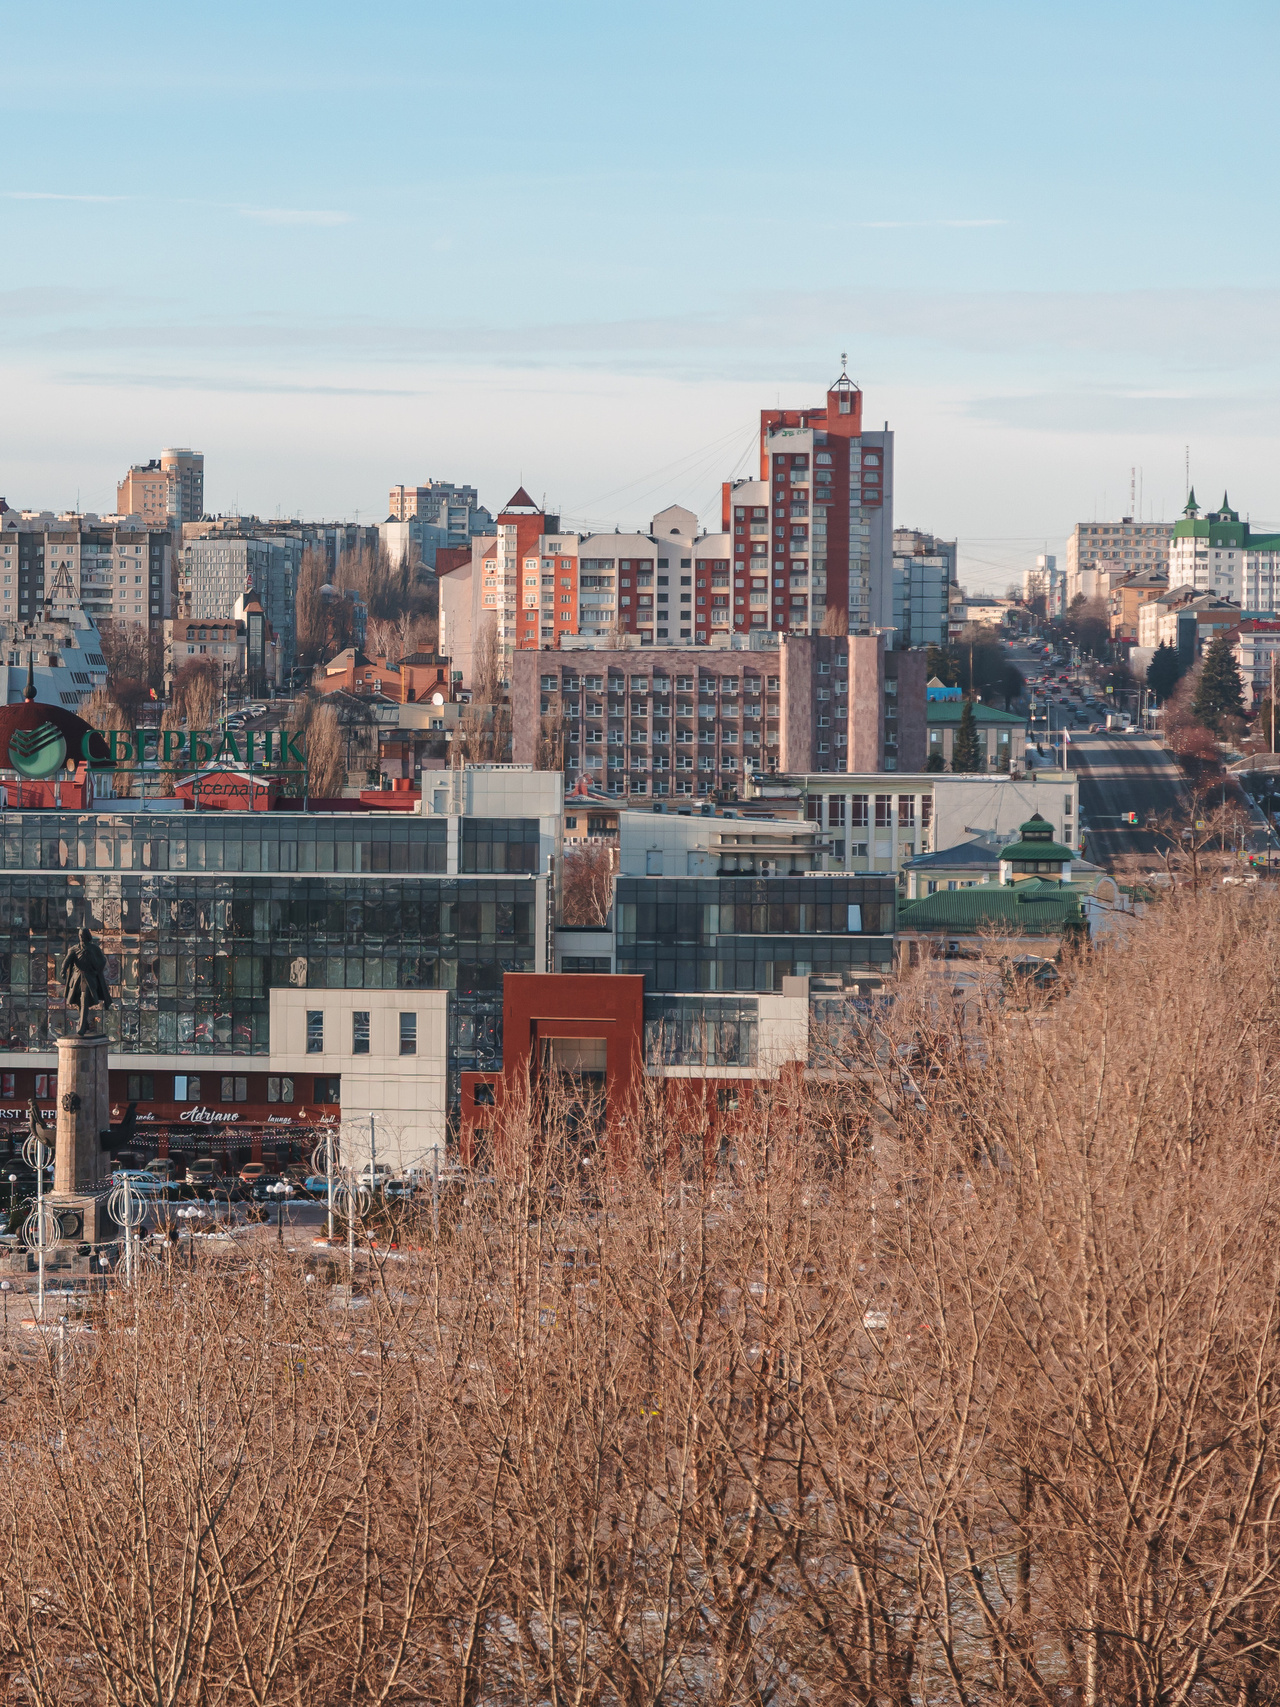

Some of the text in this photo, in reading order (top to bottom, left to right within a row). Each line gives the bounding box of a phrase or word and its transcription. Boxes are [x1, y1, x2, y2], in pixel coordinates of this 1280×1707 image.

[81, 729, 306, 763] СБЕРБАНК
[192, 780, 248, 797] Всегда
[180, 1105, 240, 1124] Adriano
